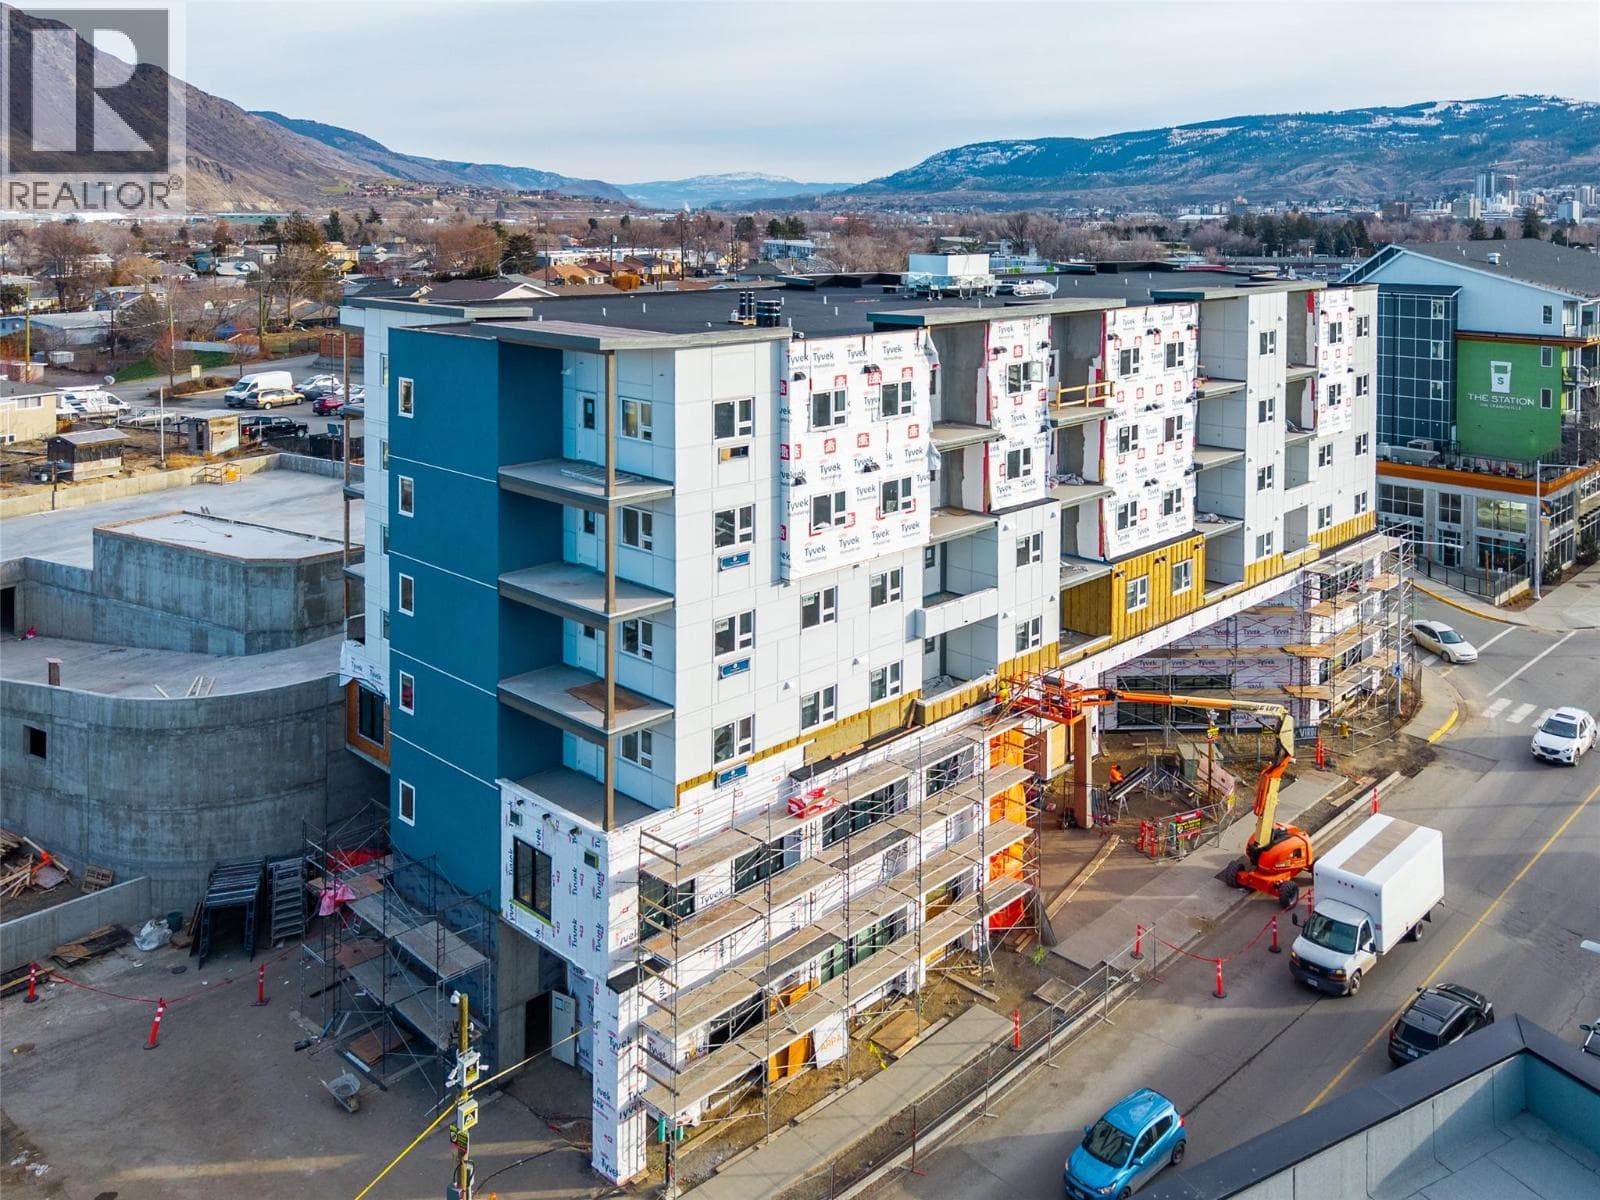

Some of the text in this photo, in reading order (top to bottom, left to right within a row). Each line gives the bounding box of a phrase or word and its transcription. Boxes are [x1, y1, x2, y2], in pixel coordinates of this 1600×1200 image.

[847, 348, 868, 359] Tyvek
[883, 344, 903, 355] Tyvek
[813, 350, 835, 362] Tyvek
[1497, 376, 1505, 385] S
[1467, 393, 1535, 407] THE STATION
[820, 462, 841, 475] Tyvek
[855, 484, 876, 496] Tyvek
[901, 520, 921, 532] Tyvek
[699, 889, 724, 908] Tyvek
